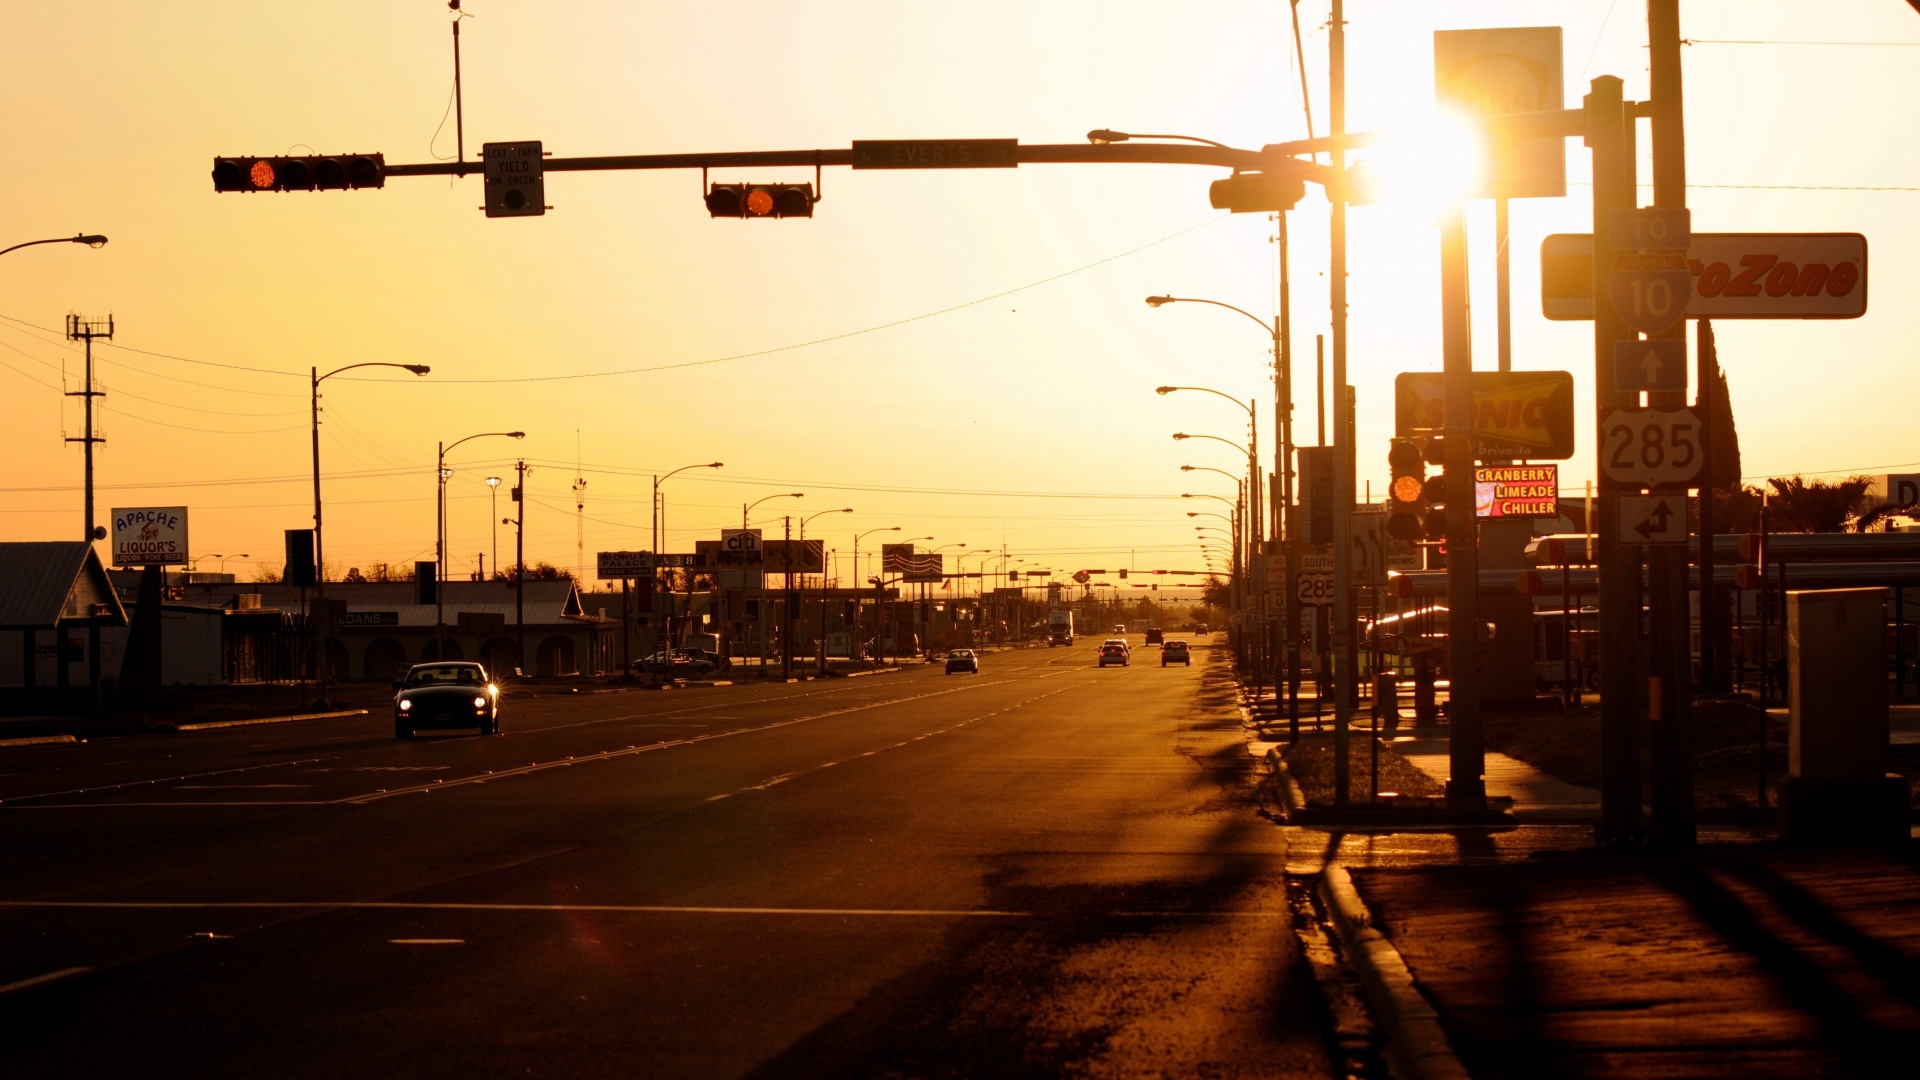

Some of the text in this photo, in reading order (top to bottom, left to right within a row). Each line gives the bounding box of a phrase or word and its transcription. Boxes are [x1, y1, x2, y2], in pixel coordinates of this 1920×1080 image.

[487, 147, 540, 159] LEFT TURN
[892, 147, 970, 162] EVERTS
[992, 150, 1007, 161] ST
[498, 161, 529, 172] YIELD
[491, 176, 535, 186] ON GREEN
[1631, 218, 1668, 240] TO
[1622, 258, 1679, 269] INTERSTATE
[1690, 254, 1859, 298] oZone
[1631, 279, 1673, 316] 10
[1414, 398, 1550, 430] SNIC
[1610, 424, 1694, 468] 285
[1475, 469, 1554, 482] CRANBERRY
[1494, 485, 1555, 498] LIMEADE
[1502, 502, 1555, 514] CHILLER
[116, 511, 178, 531] APACHE
[120, 541, 176, 553] LIQUOR'S
[117, 554, 142, 562] LIQUOR
[165, 553, 181, 561] BEER
[1304, 557, 1333, 568] SOUTH
[1353, 570, 1370, 581] ONLY
[1301, 580, 1335, 598] 285
[339, 614, 381, 624] LOANS
